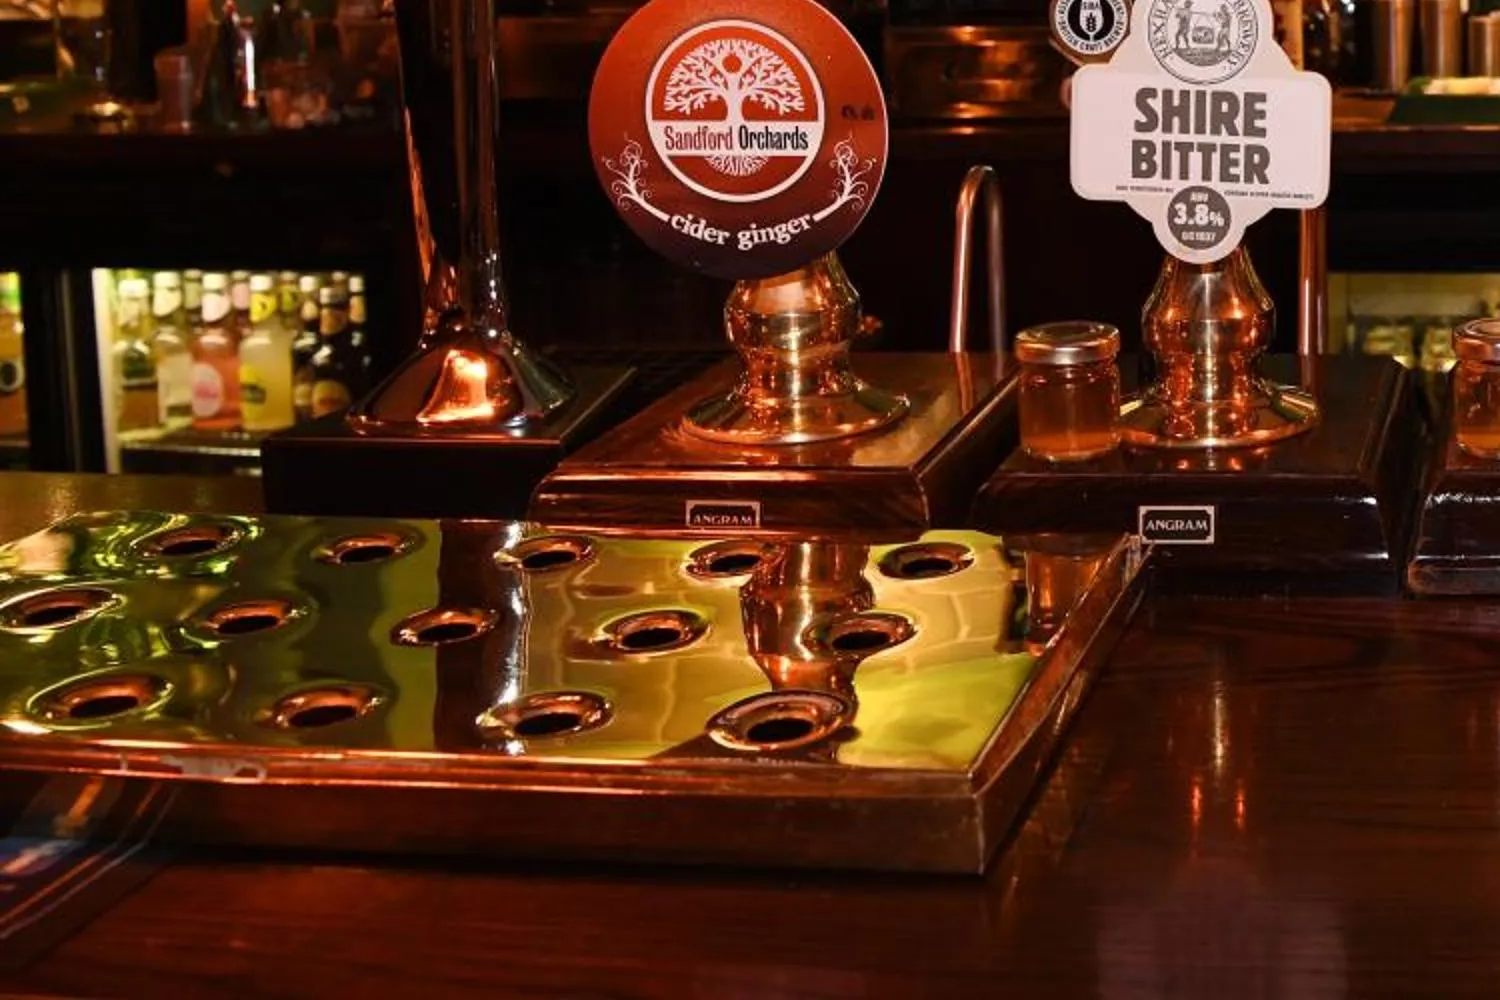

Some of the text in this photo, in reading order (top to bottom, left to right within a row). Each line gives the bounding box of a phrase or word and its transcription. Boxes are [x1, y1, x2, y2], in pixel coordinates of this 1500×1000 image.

[1134, 87, 1268, 138] SHIRE
[665, 125, 809, 150] Sandford Orchards
[1131, 139, 1271, 185] BITTER
[1173, 202, 1225, 227] 3.8%
[670, 213, 814, 250] cider ginger
[692, 514, 753, 526] ANGRAM
[1145, 519, 1208, 531] ANGRAM
